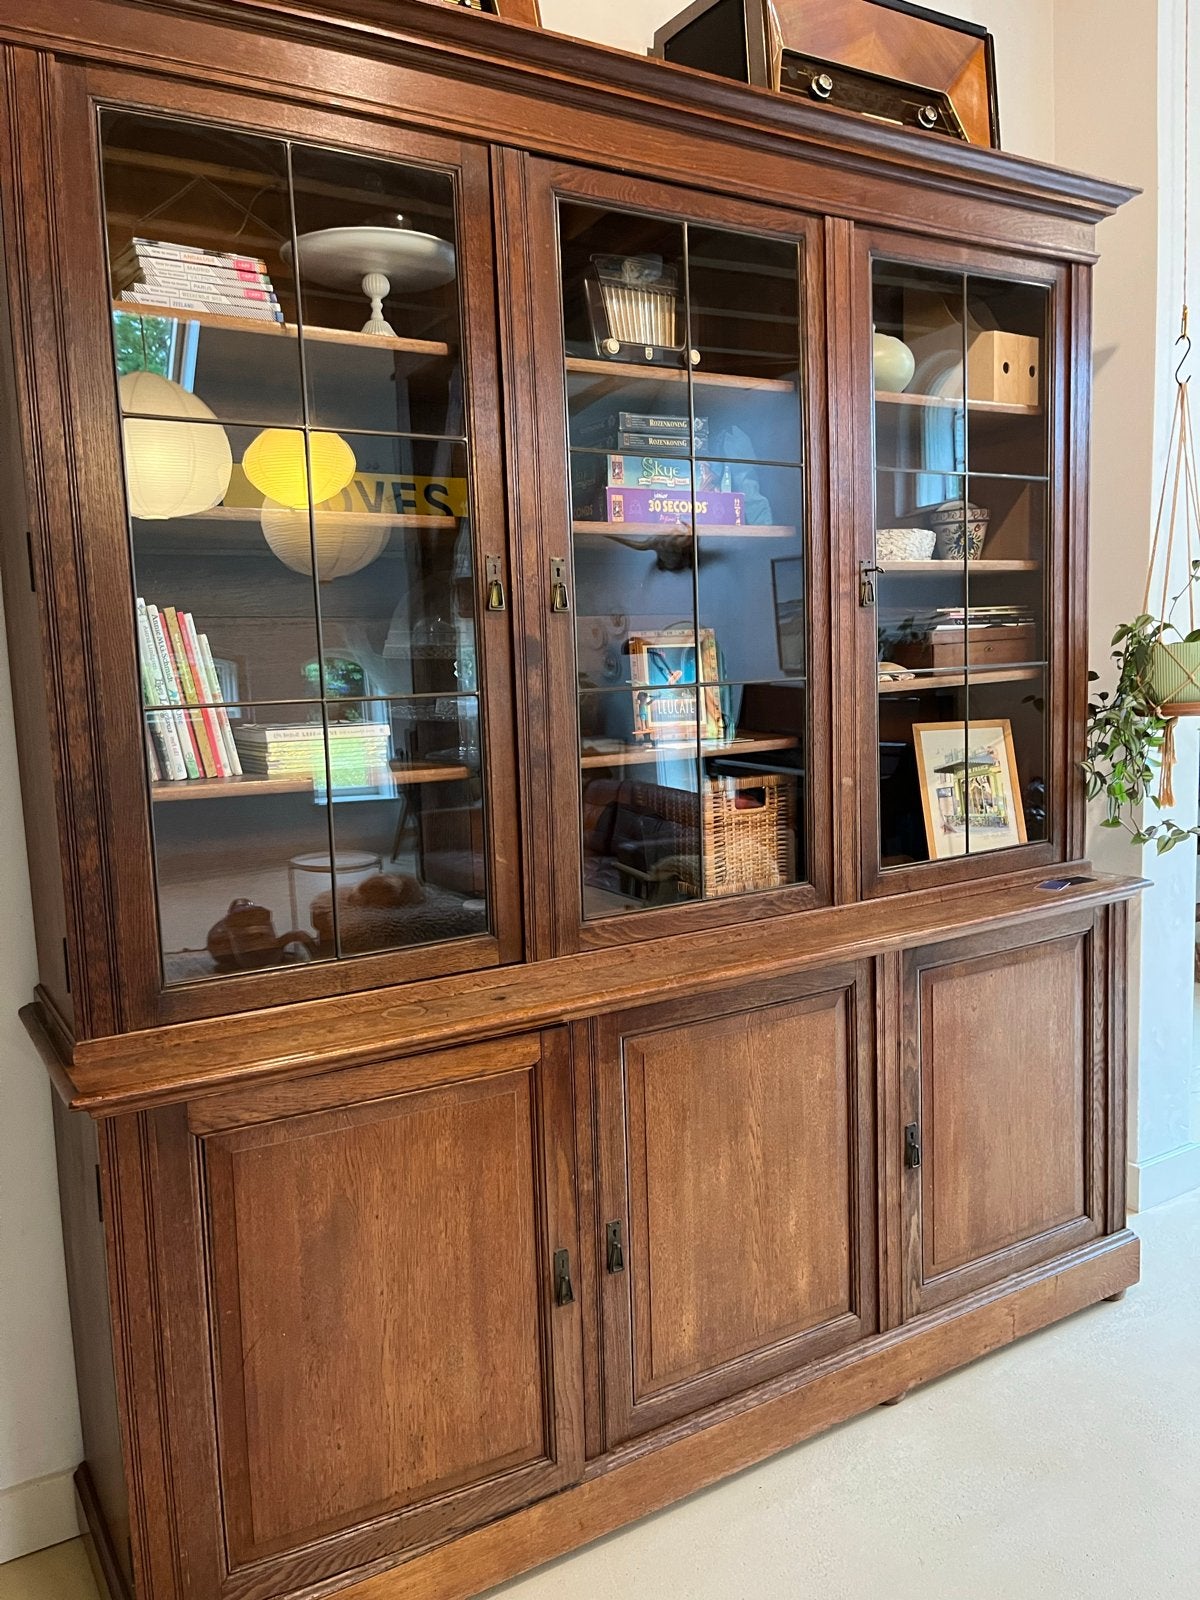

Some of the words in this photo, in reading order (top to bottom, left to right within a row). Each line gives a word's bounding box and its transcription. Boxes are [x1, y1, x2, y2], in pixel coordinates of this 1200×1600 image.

[649, 418, 688, 428] ROZENKONING
[648, 437, 687, 447] ROZENKONING
[642, 456, 681, 479] Skye
[648, 499, 661, 513] 30
